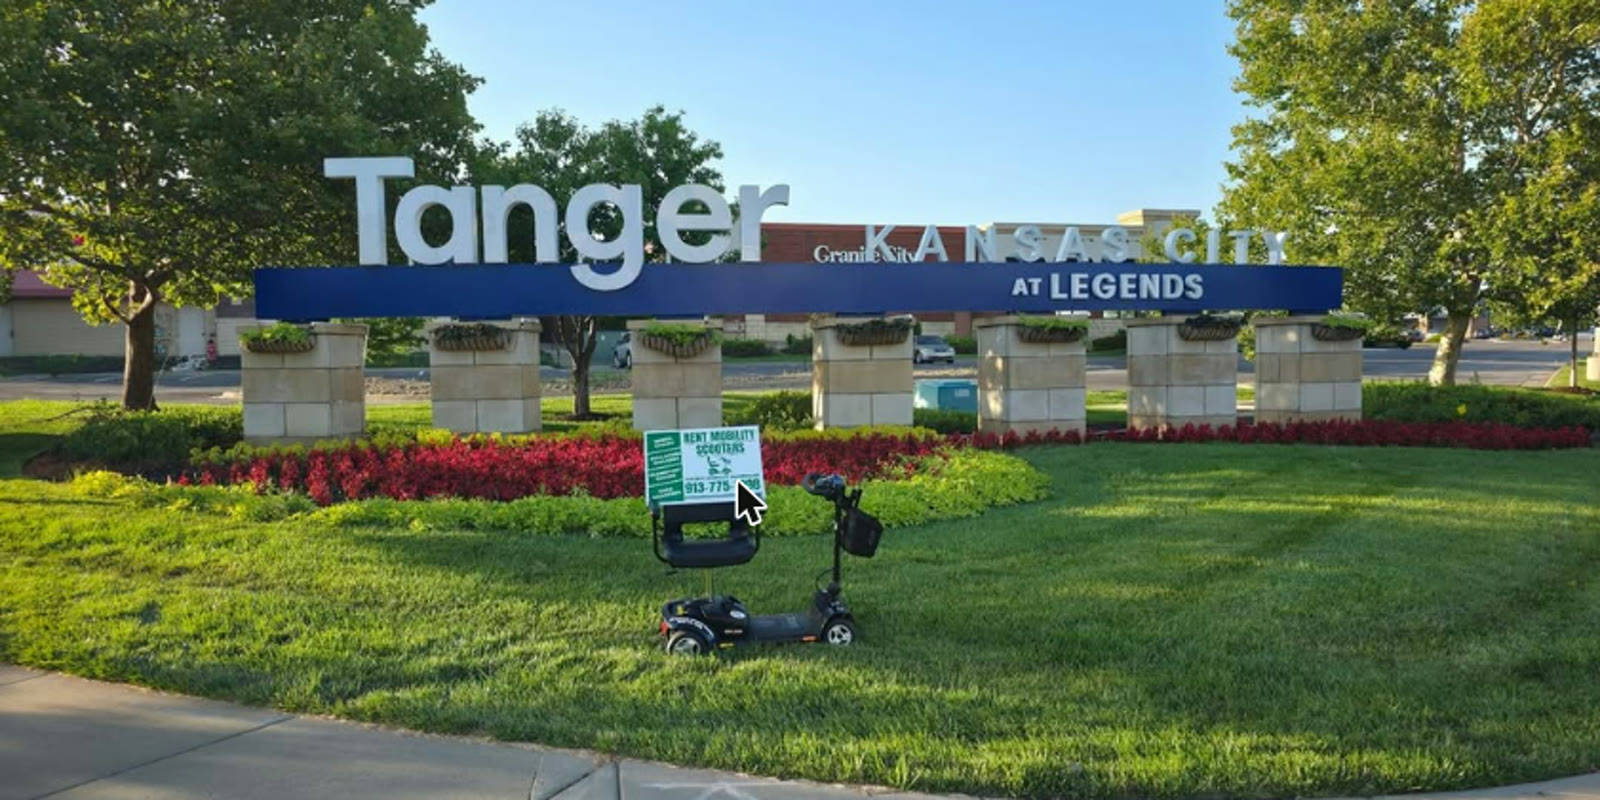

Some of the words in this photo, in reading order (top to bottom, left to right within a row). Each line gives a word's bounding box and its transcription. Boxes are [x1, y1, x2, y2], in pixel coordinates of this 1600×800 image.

[324, 157, 789, 291] Tanger
[865, 225, 1130, 263] KANSAS
[1164, 228, 1289, 265] CITY
[1011, 277, 1042, 296] AT
[1050, 272, 1204, 300] LEGENDS
[683, 431, 707, 443] RENT
[711, 428, 755, 441] MOBILITY
[696, 442, 745, 455] SCOOTERS
